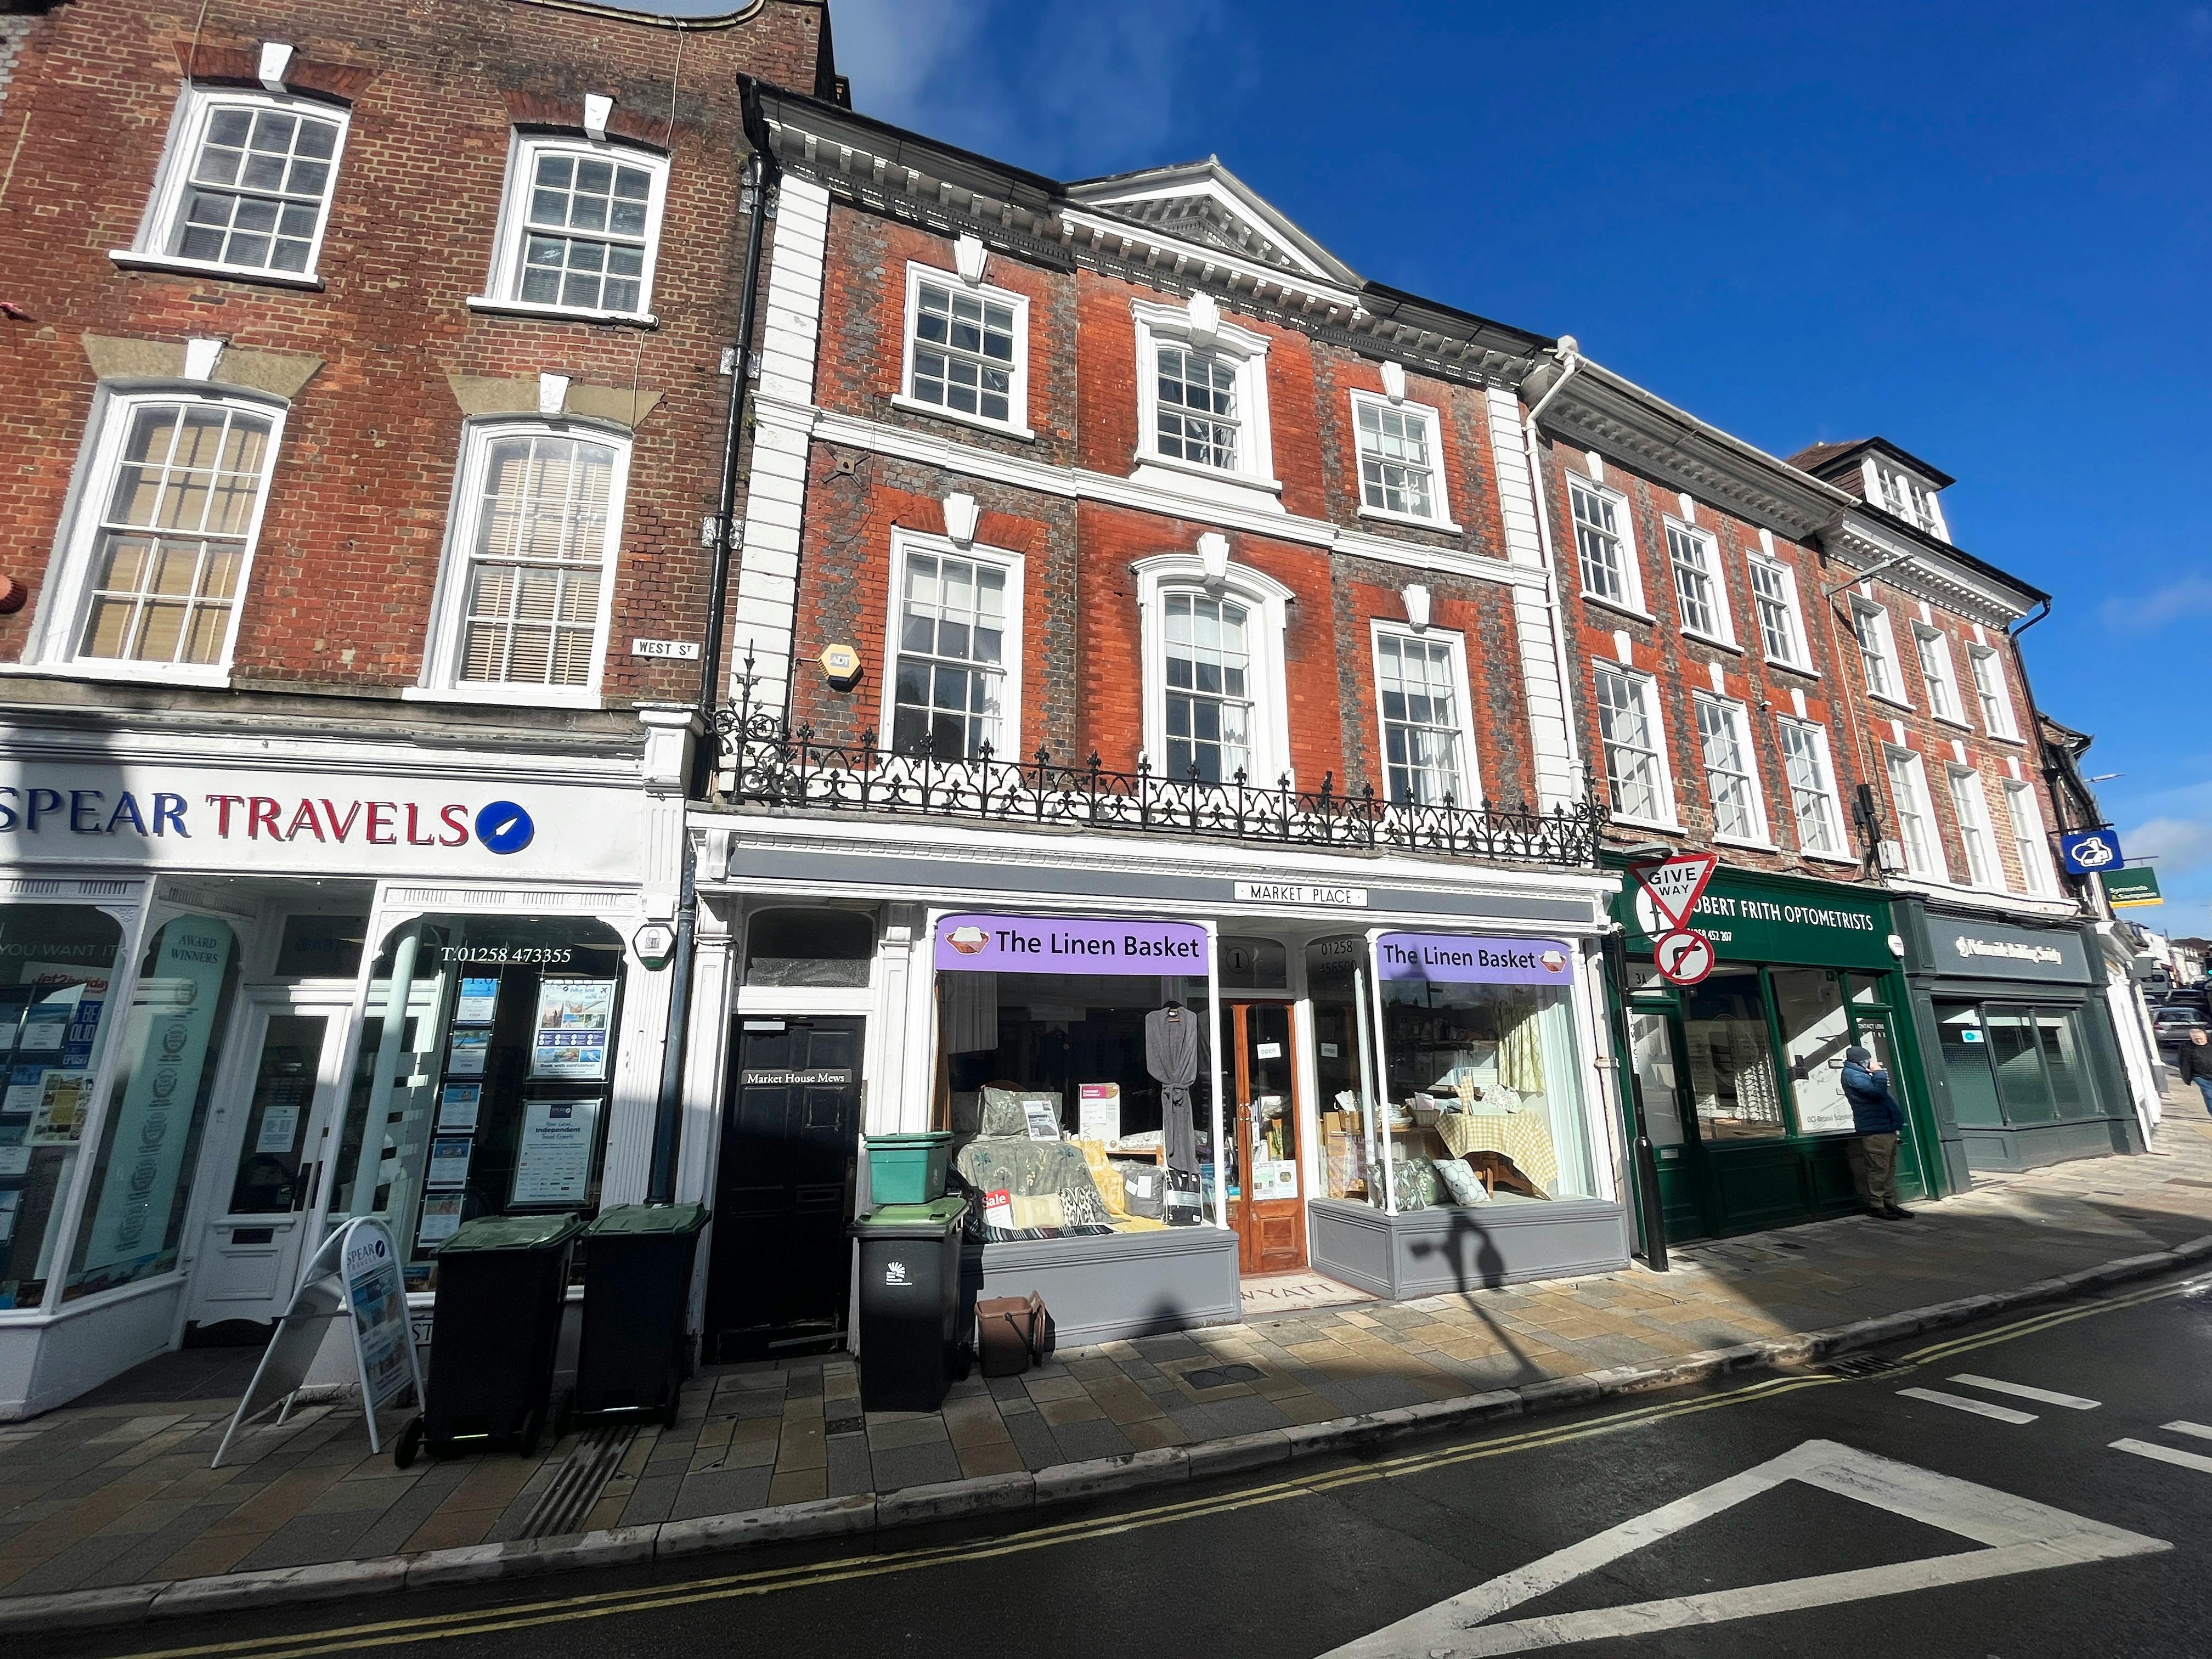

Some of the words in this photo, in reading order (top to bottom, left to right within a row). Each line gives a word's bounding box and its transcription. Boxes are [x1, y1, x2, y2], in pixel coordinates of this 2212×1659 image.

[639, 641, 672, 654] WEST
[679, 645, 692, 655] ST
[831, 655, 850, 668] ADT
[0, 786, 191, 839] SPEAR
[205, 794, 469, 847] TRAVELS
[1648, 867, 1697, 885] GIVE
[1250, 885, 1302, 901] MARKET
[1313, 888, 1351, 904] PLACE
[1658, 884, 1689, 896] WAY
[1740, 900, 1781, 922] FRITH
[1784, 904, 1874, 932] OPTOMETRISTS
[178, 934, 217, 949] AWARD
[995, 930, 1042, 953] The
[1051, 933, 1115, 956] Linen
[1124, 935, 1200, 958] Basket
[1322, 940, 1353, 956] 01258
[43, 944, 97, 957] WANT
[171, 948, 219, 964] WINNERS
[512, 948, 572, 963] 473355
[1383, 944, 1418, 964] The
[1424, 946, 1474, 967] Linen
[1479, 949, 1537, 969] Basket
[1635, 973, 1647, 985] 3A
[747, 1074, 783, 1084] Market
[785, 1074, 815, 1084] House
[817, 1073, 845, 1083] Mews
[982, 1193, 1007, 1207] Sale
[347, 1243, 375, 1266] SPEAR
